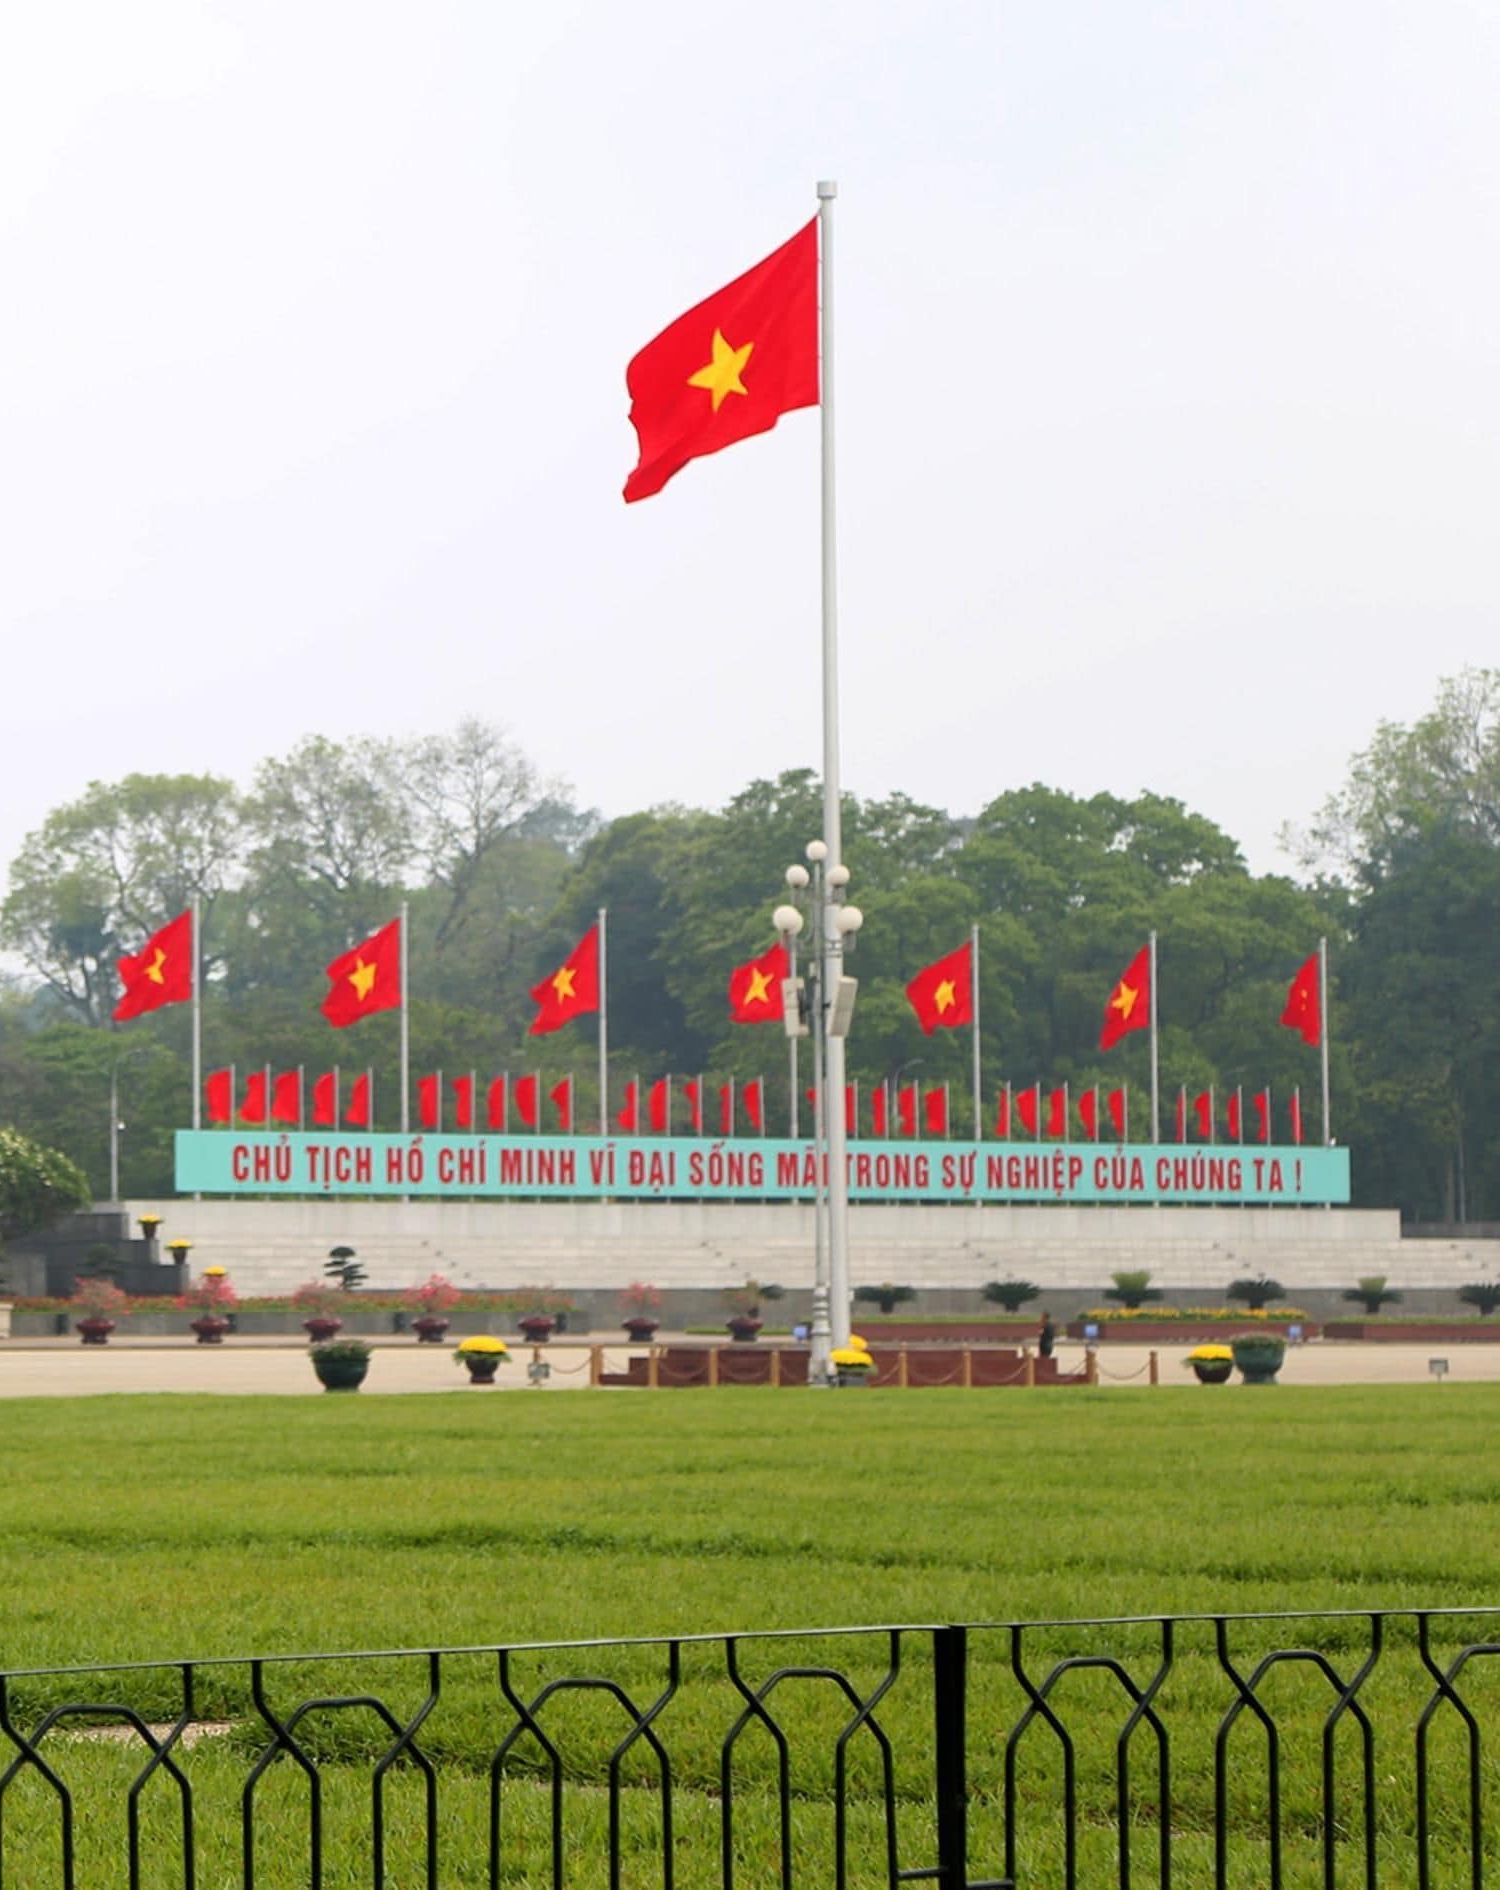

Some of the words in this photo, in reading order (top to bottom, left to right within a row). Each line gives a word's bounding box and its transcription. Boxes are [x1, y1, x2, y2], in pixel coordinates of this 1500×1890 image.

[233, 1134, 291, 1182] CHỦ
[306, 1146, 372, 1190] TỊCH
[438, 1139, 486, 1184] CHÍ
[501, 1149, 575, 1185] MINH
[629, 1150, 675, 1193] ĐẠI
[689, 1140, 763, 1188] SỐNG
[942, 1150, 977, 1195] SỰ
[987, 1148, 1083, 1197] NGHIỆP
[1094, 1145, 1144, 1190] CỦA
[1156, 1150, 1242, 1191] CHÚNG
[1254, 1159, 1283, 1192] TA
